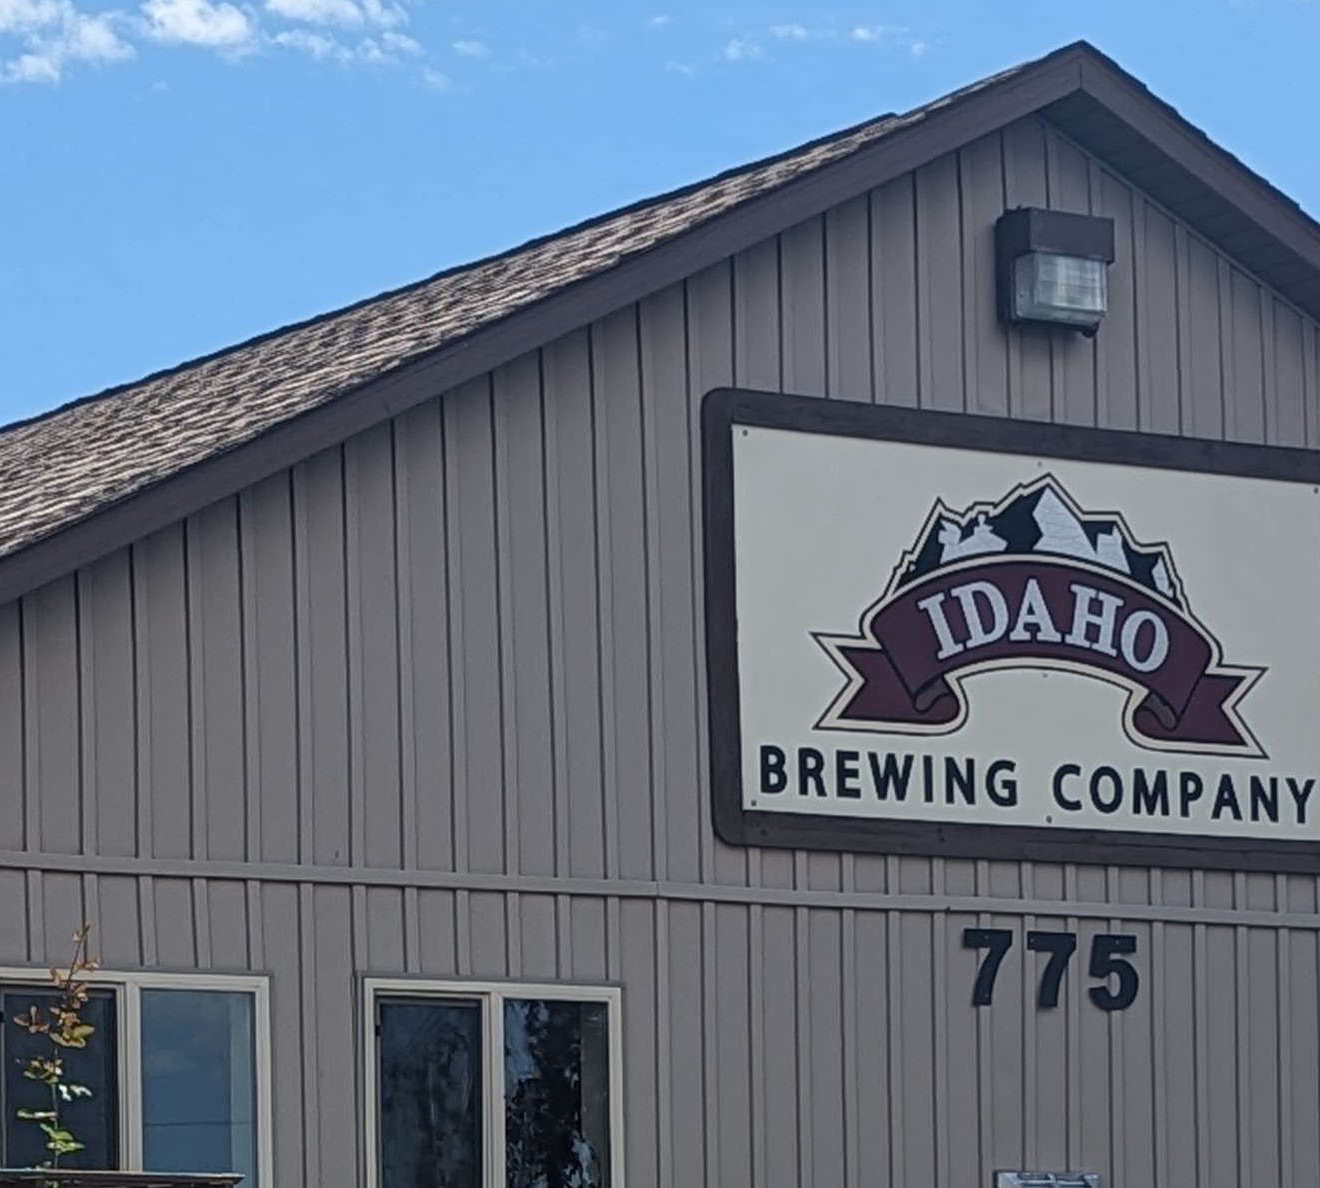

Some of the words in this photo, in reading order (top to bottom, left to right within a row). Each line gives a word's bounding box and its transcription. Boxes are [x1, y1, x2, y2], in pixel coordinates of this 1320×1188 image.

[917, 577, 1170, 674] IDAHO
[758, 744, 1019, 808] BREWING
[1052, 764, 1316, 825] COMPANY
[962, 927, 1139, 1012] 775
